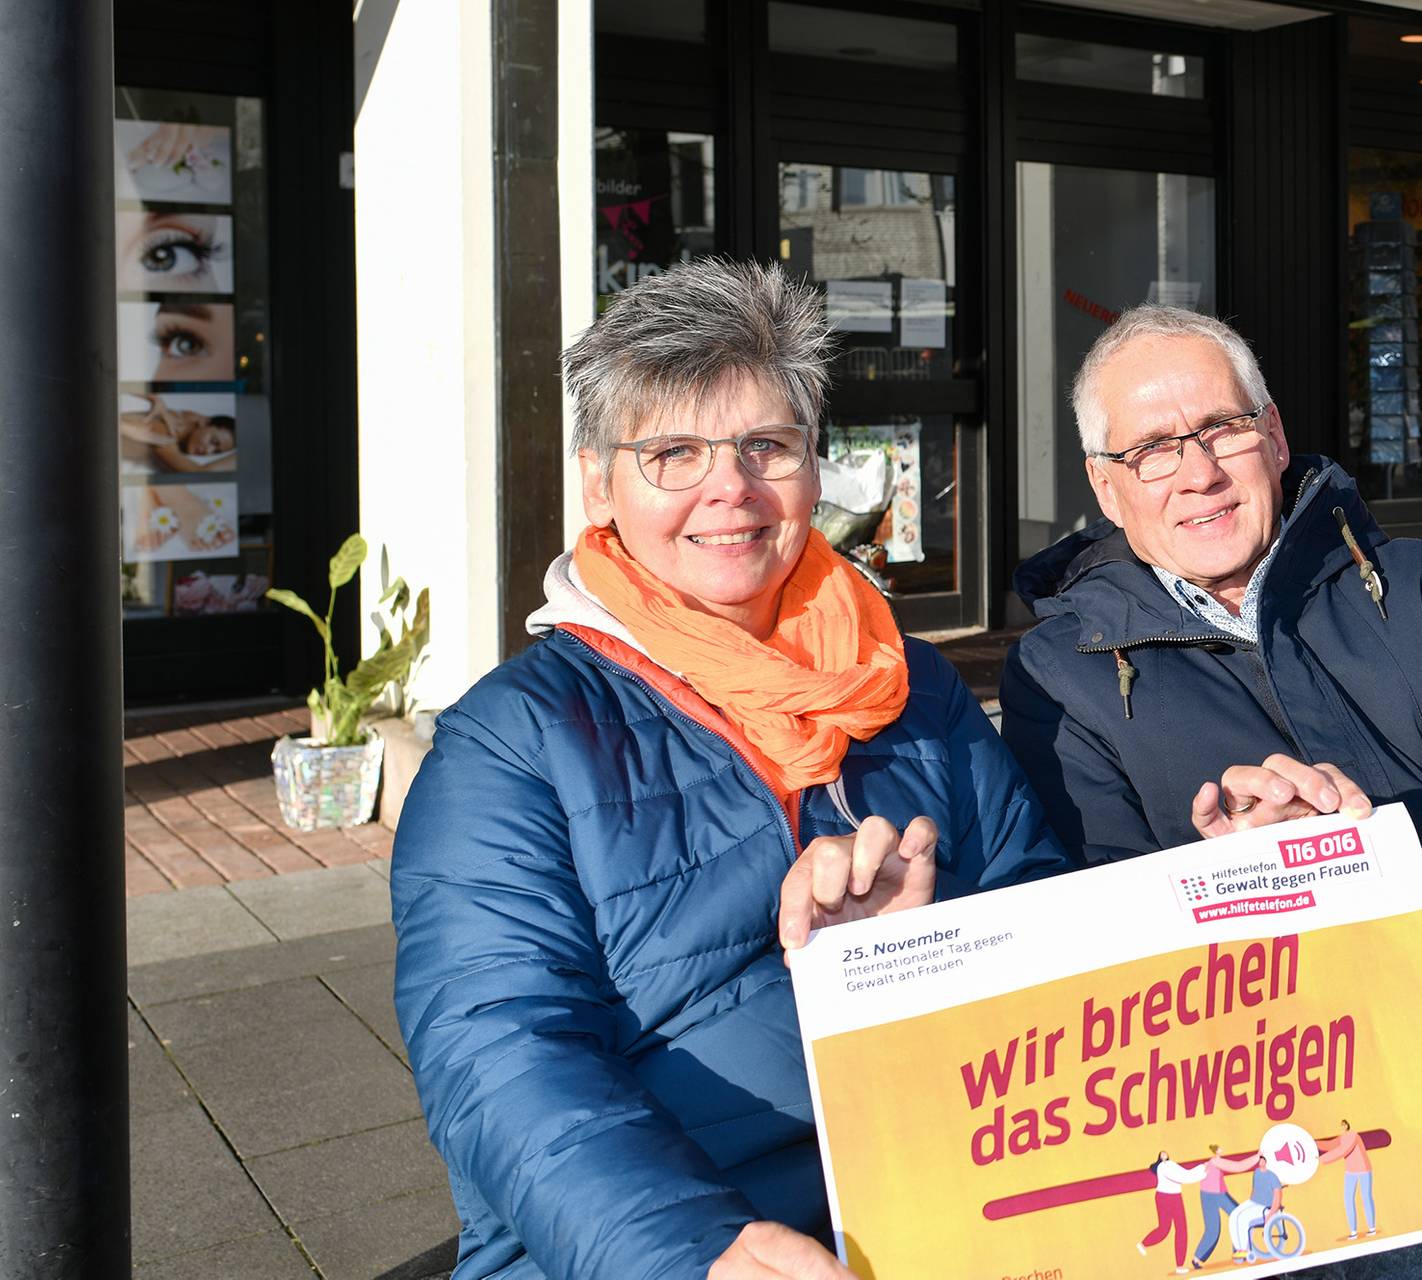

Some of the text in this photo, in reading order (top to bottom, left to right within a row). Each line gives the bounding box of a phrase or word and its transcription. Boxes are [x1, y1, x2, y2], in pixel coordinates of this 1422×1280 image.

[1285, 832, 1357, 864] 116 016
[1211, 861, 1278, 880] Hilfetelefon
[1216, 860, 1370, 895] Gewalt gegen Frauen
[1198, 894, 1310, 920] www.hilfetelefon.de
[842, 928, 961, 963] 25. November
[844, 930, 1013, 978] Internationaler Tag gegen
[846, 957, 964, 992] Gewalt an Frauen
[960, 933, 1300, 1110] Wir brechen
[971, 1014, 1356, 1167] das Schweigen
[1001, 1268, 1063, 1280] chen
